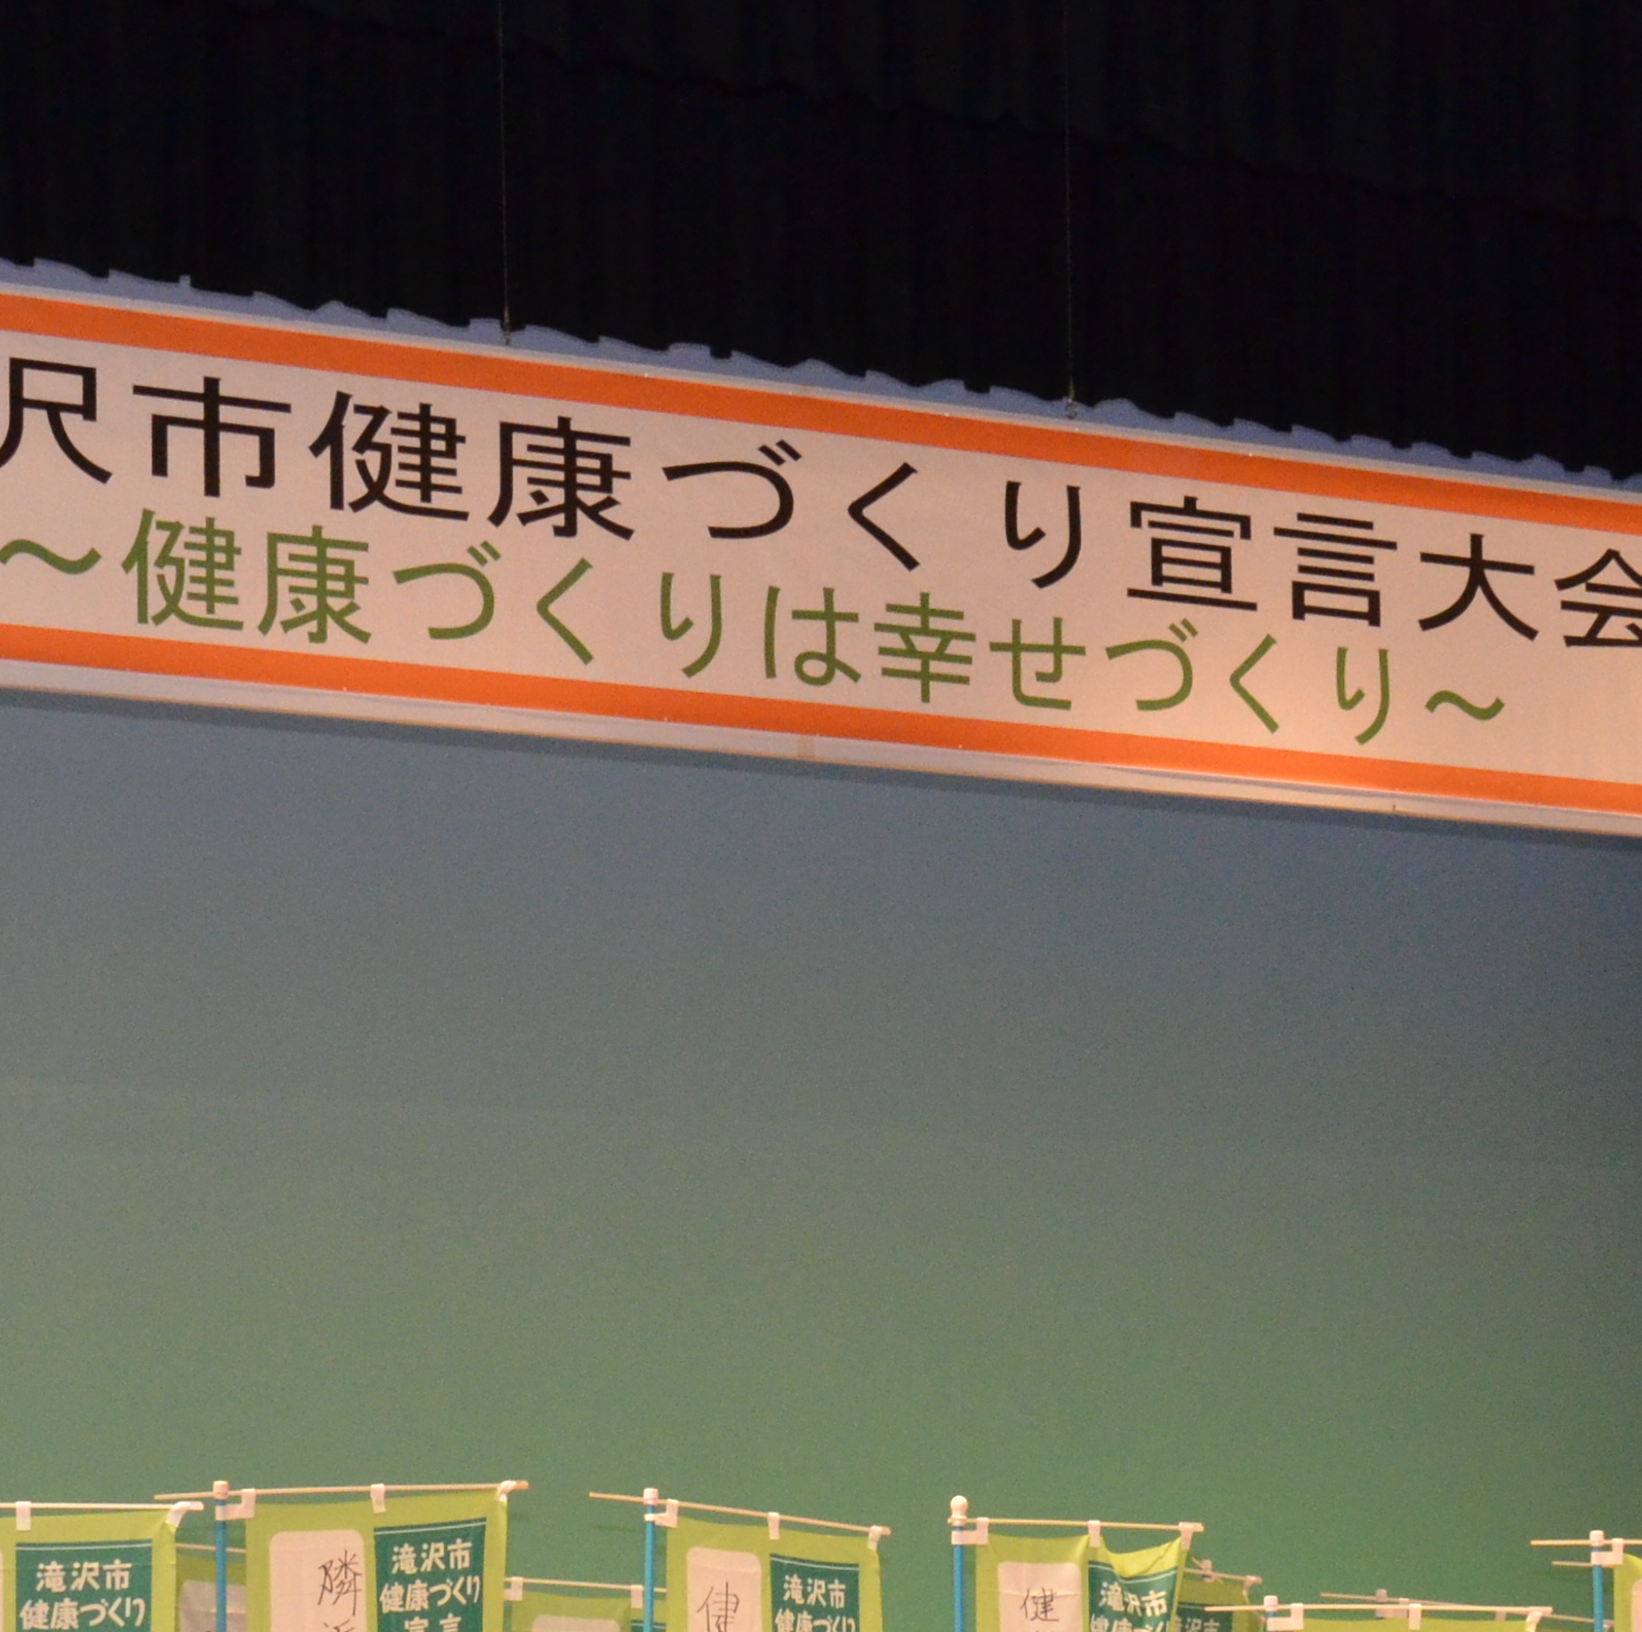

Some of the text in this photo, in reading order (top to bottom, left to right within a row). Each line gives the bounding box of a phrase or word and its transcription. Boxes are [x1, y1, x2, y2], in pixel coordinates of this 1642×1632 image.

[392, 1540, 472, 1574] 滝沢市
[36, 1562, 132, 1591] 滝沢市
[784, 1576, 846, 1609] 滝沢市
[380, 1578, 480, 1612] 健康づくり
[19, 1598, 146, 1630] 健康づくり
